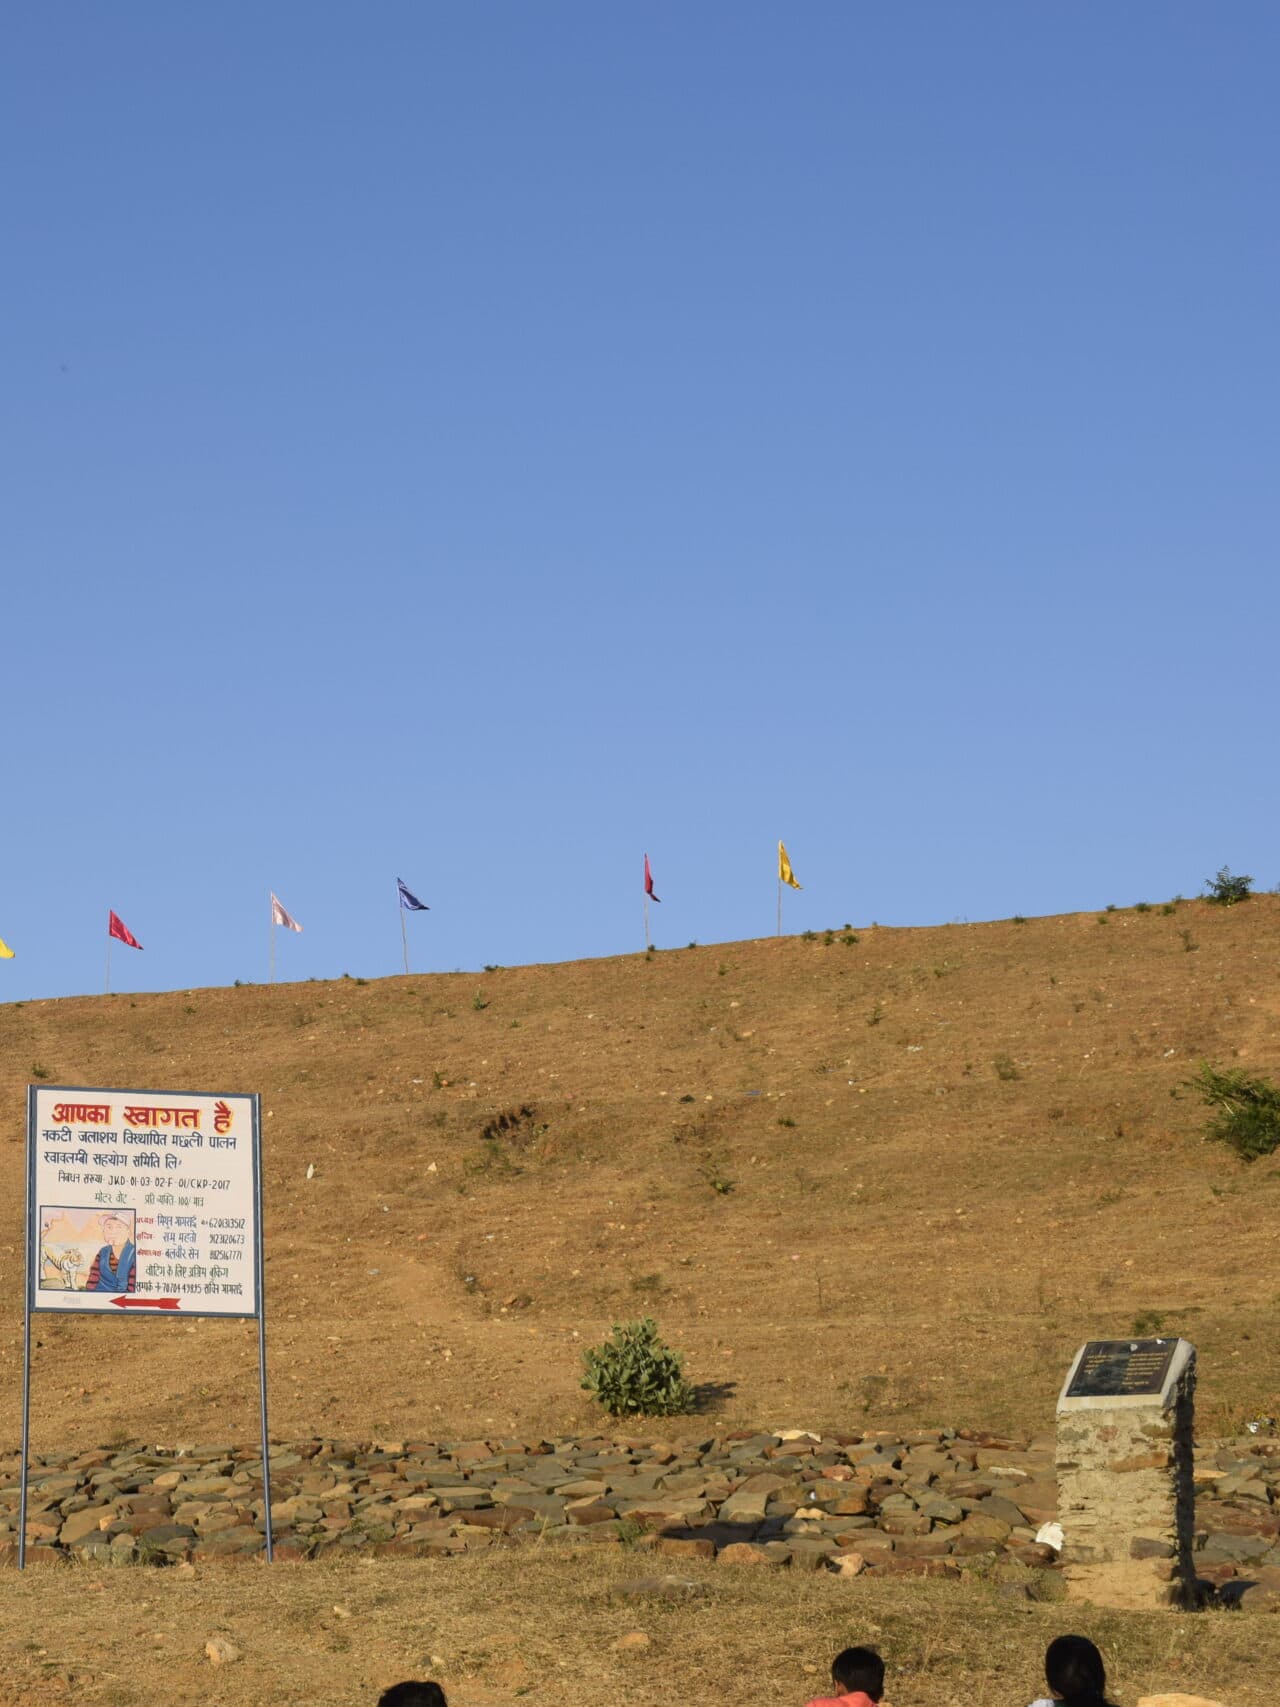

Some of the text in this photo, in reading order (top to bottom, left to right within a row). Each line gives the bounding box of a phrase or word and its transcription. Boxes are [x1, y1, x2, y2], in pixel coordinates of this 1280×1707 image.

[52, 1101, 232, 1133] आपका स्वागत है
[42, 1126, 237, 1150] नकटी जलाशय विस्थापित मछली पालन
[44, 1149, 88, 1165] स्वावलम्बी
[92, 1150, 128, 1167] सहयोग
[132, 1151, 160, 1168] समिति
